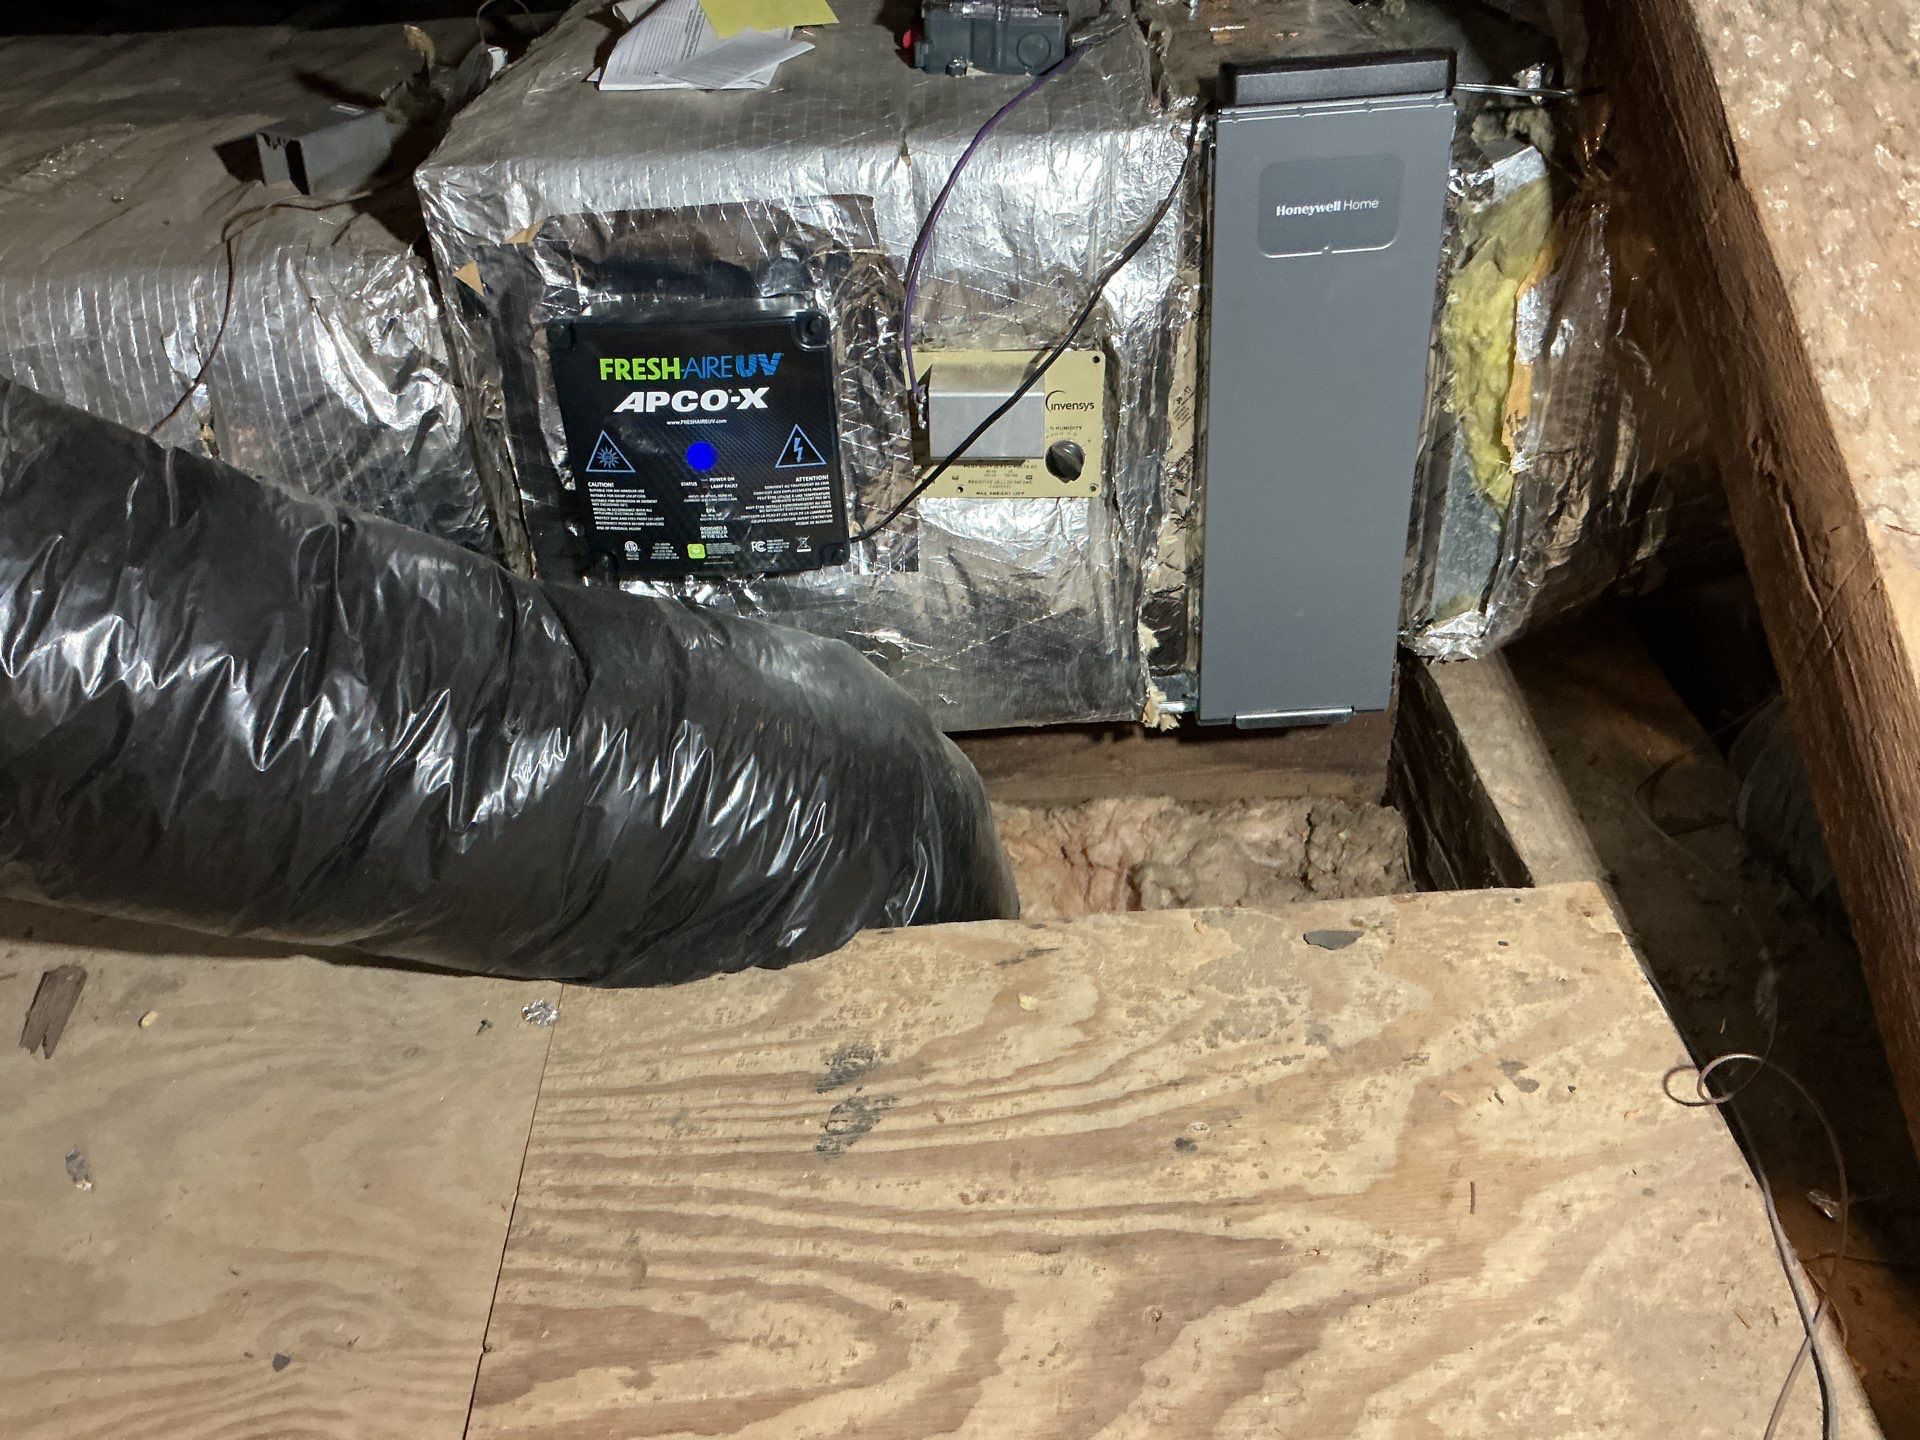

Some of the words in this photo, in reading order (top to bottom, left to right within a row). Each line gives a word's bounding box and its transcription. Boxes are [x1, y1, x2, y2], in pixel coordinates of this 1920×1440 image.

[1276, 200, 1341, 216] Honeywell
[1343, 199, 1379, 211] Home
[735, 352, 783, 378] UV
[1051, 402, 1095, 412] invensys
[795, 474, 829, 482] ATTENTION!
